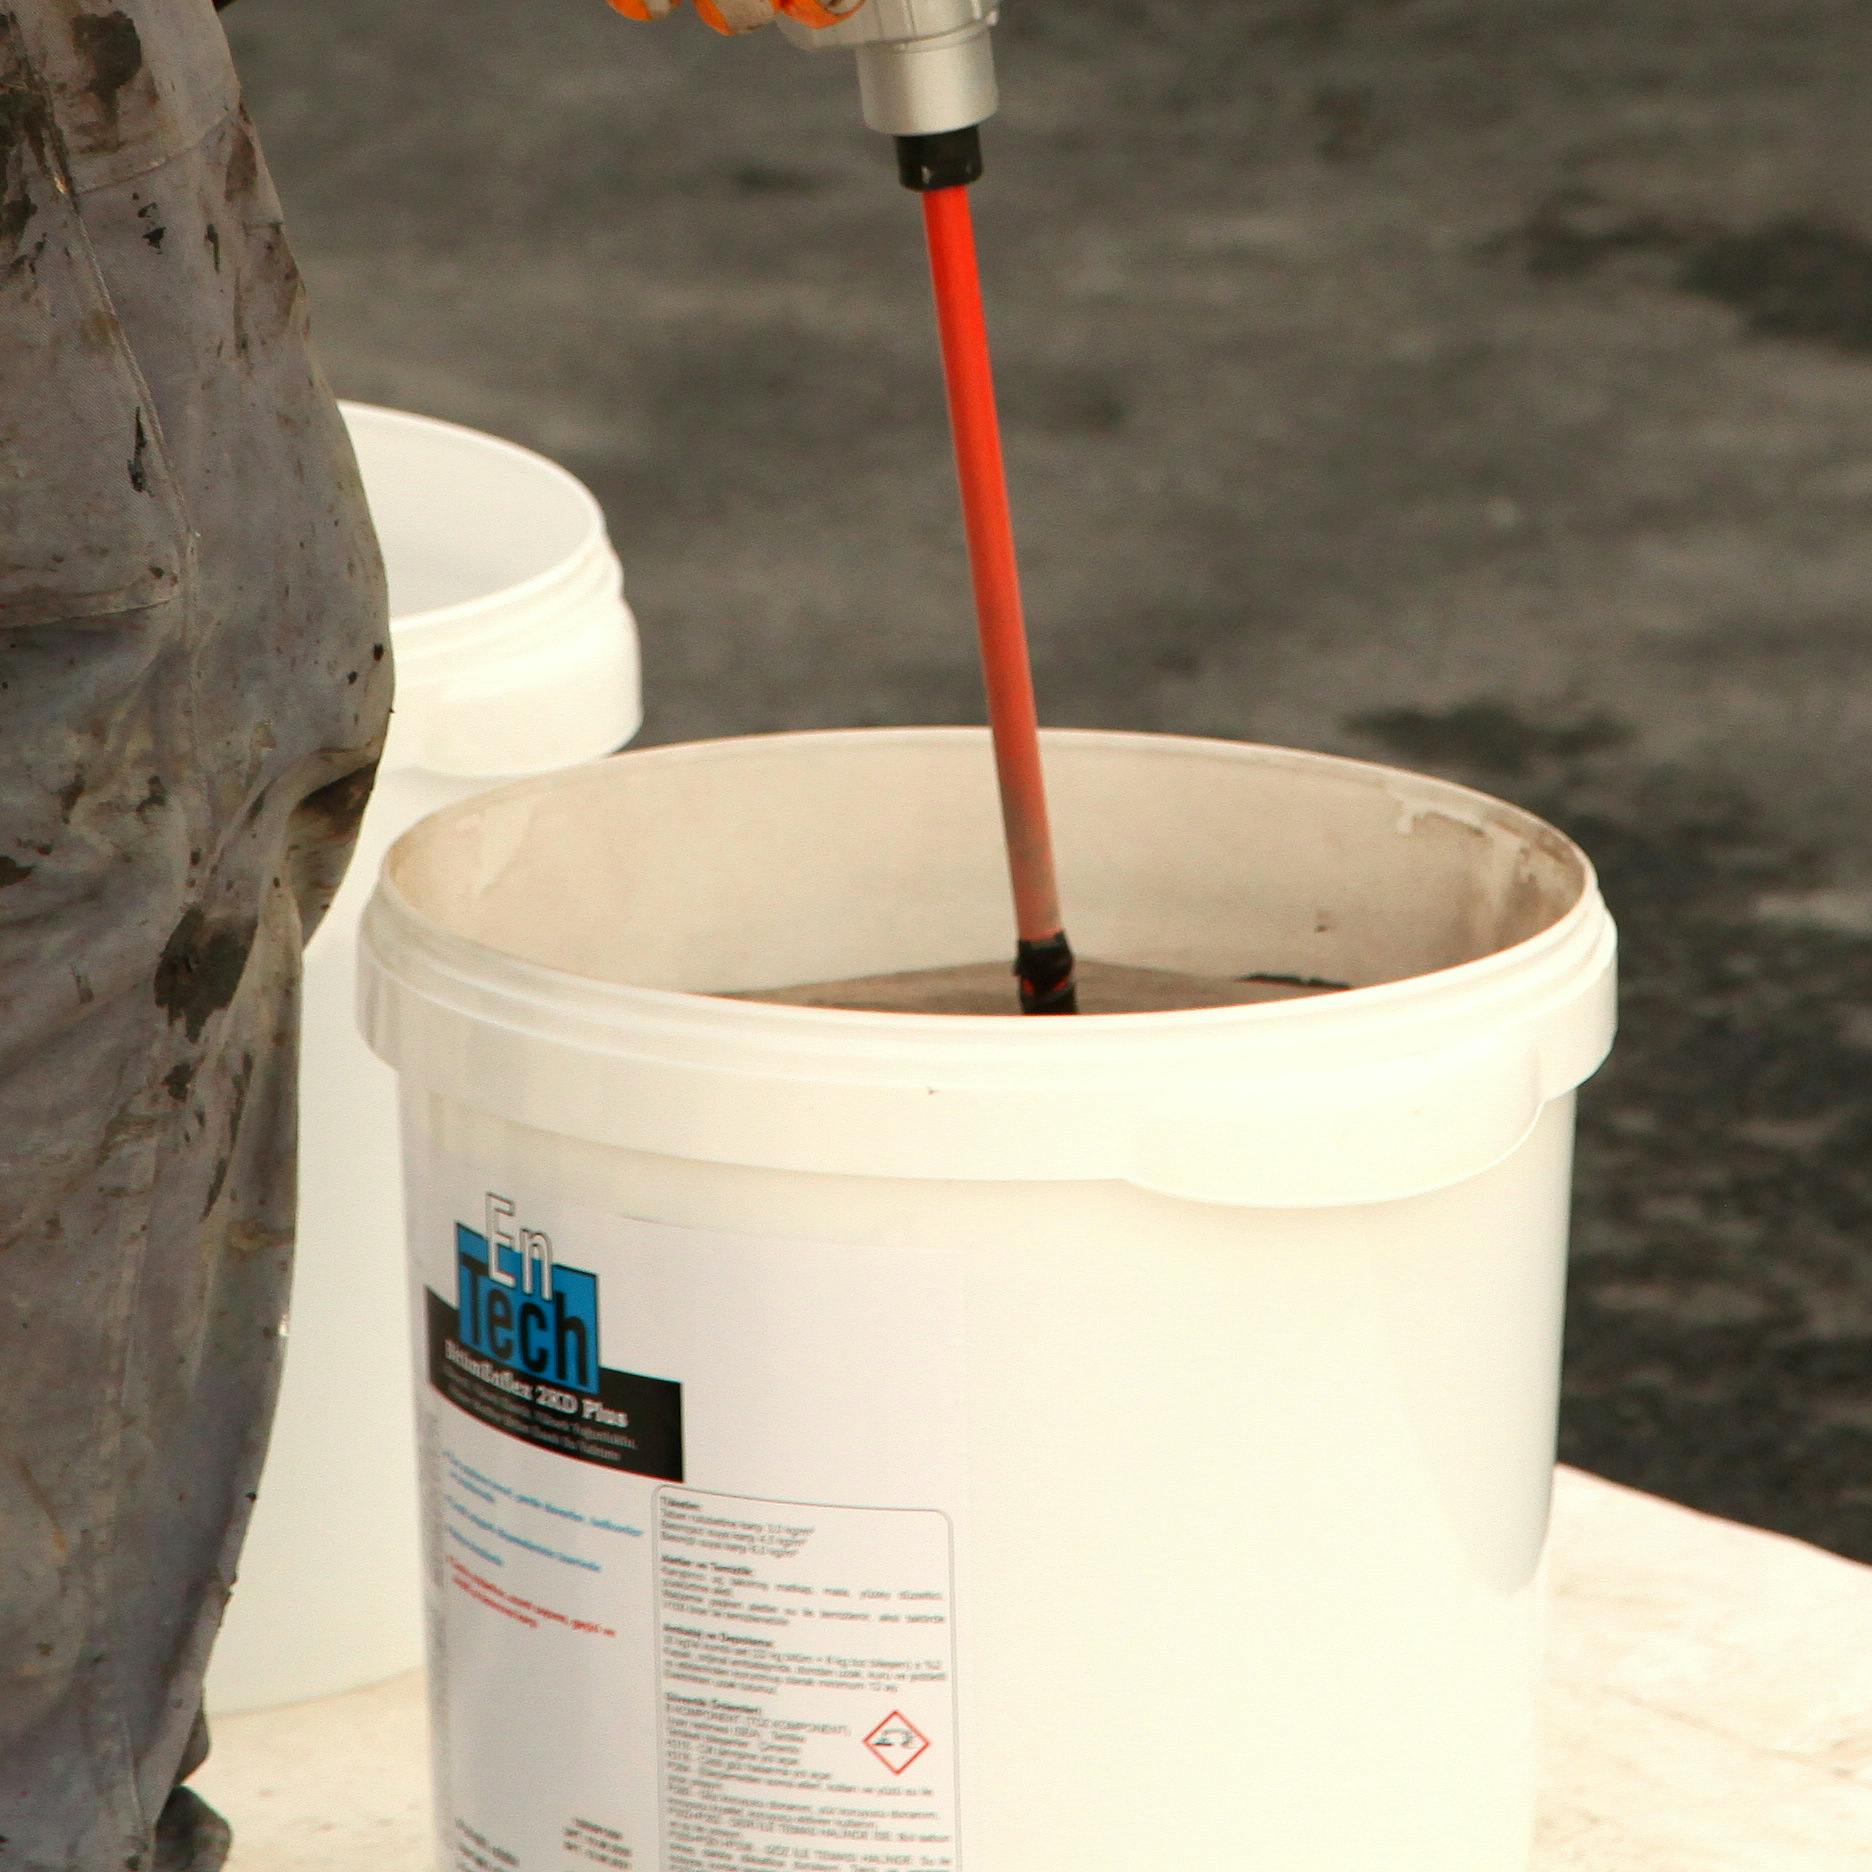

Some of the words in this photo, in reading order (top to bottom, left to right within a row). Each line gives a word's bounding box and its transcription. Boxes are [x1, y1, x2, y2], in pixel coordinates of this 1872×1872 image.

[484, 1190, 554, 1302] En
[459, 1250, 589, 1388] Tech
[581, 1397, 630, 1429] Plus
